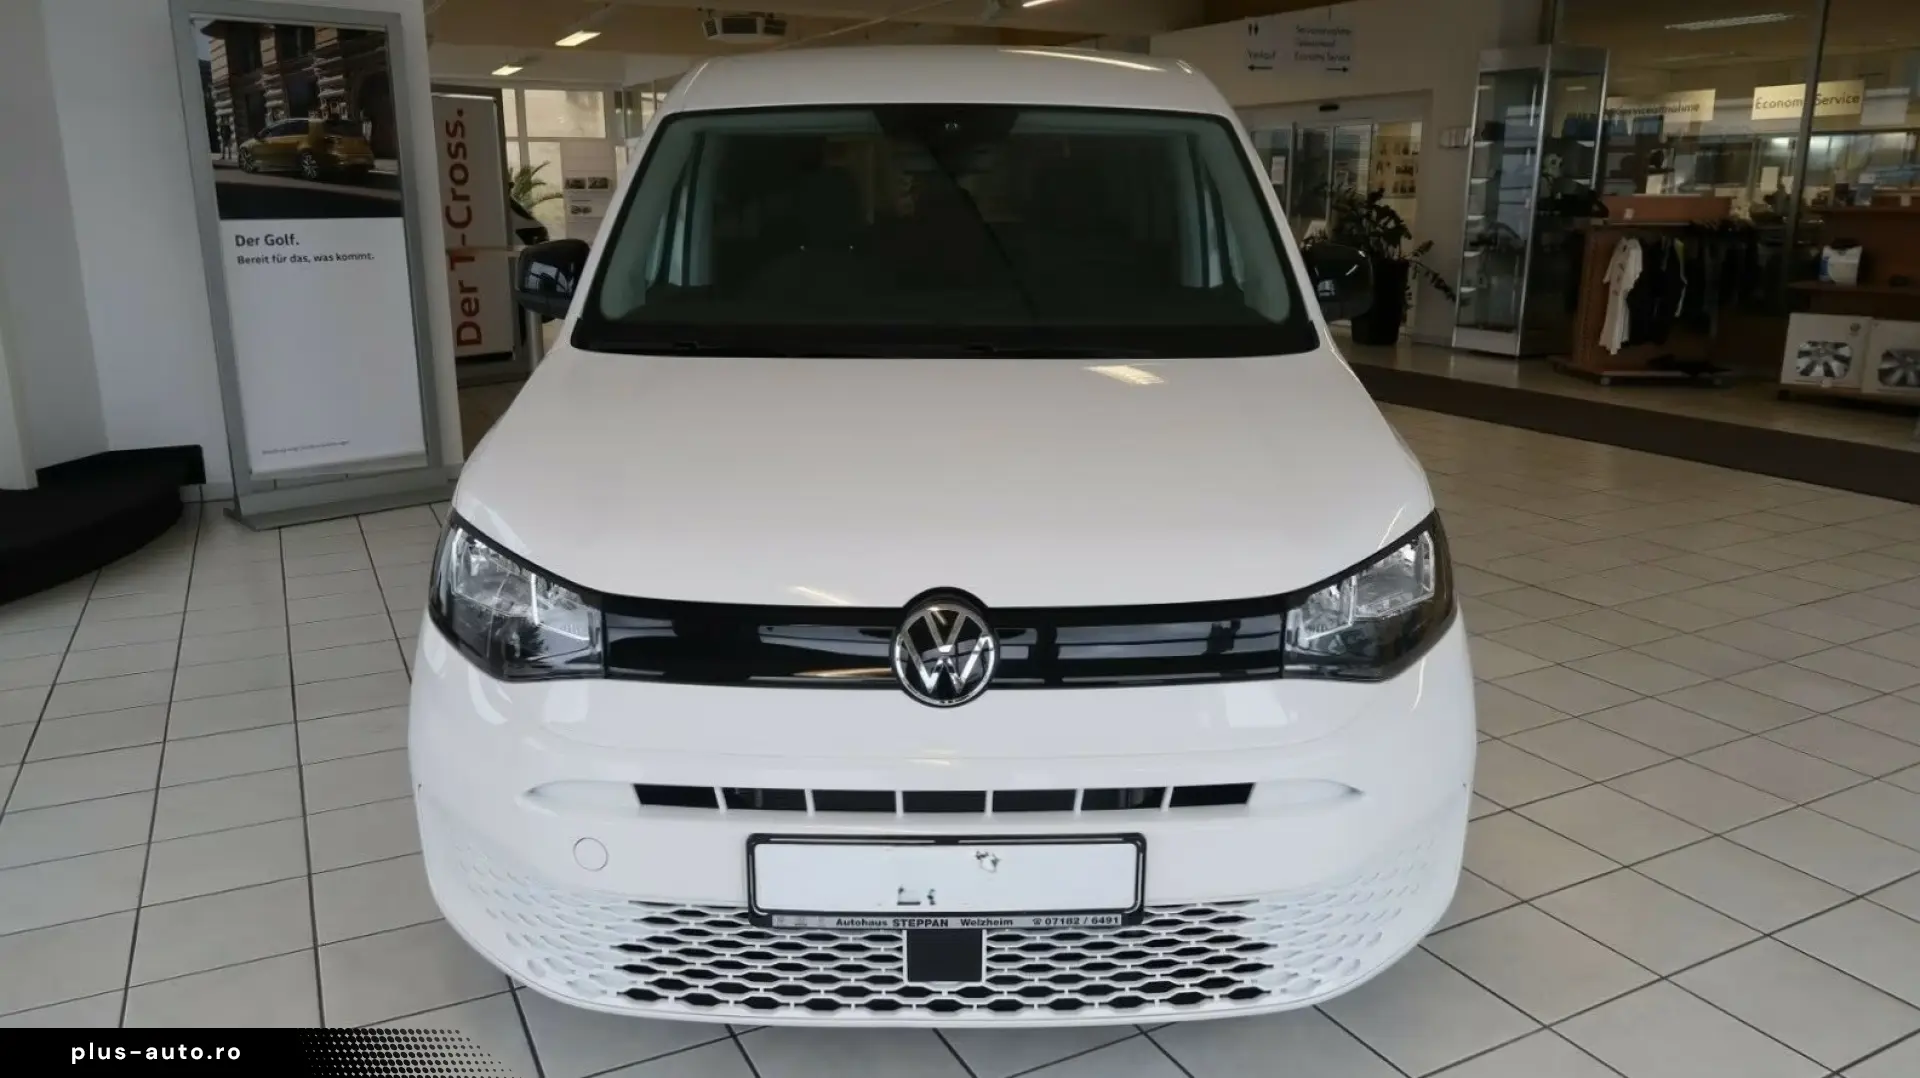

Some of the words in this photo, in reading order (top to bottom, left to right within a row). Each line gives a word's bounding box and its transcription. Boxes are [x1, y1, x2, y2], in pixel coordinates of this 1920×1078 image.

[1755, 96, 1804, 110] Econom
[1815, 91, 1861, 106] Service
[445, 107, 476, 272] T-Cross.
[234, 234, 260, 247] Der
[263, 233, 300, 246] Golf.
[236, 254, 269, 265] Bereit
[272, 253, 287, 264] für
[290, 253, 311, 265] das,
[313, 254, 334, 262] was
[335, 252, 375, 263] kommt.
[456, 279, 482, 347] Der
[835, 917, 889, 927] Autohaus
[892, 918, 949, 928] STEPPAN
[960, 917, 1014, 927] Welzheim
[1045, 916, 1080, 926] 07182
